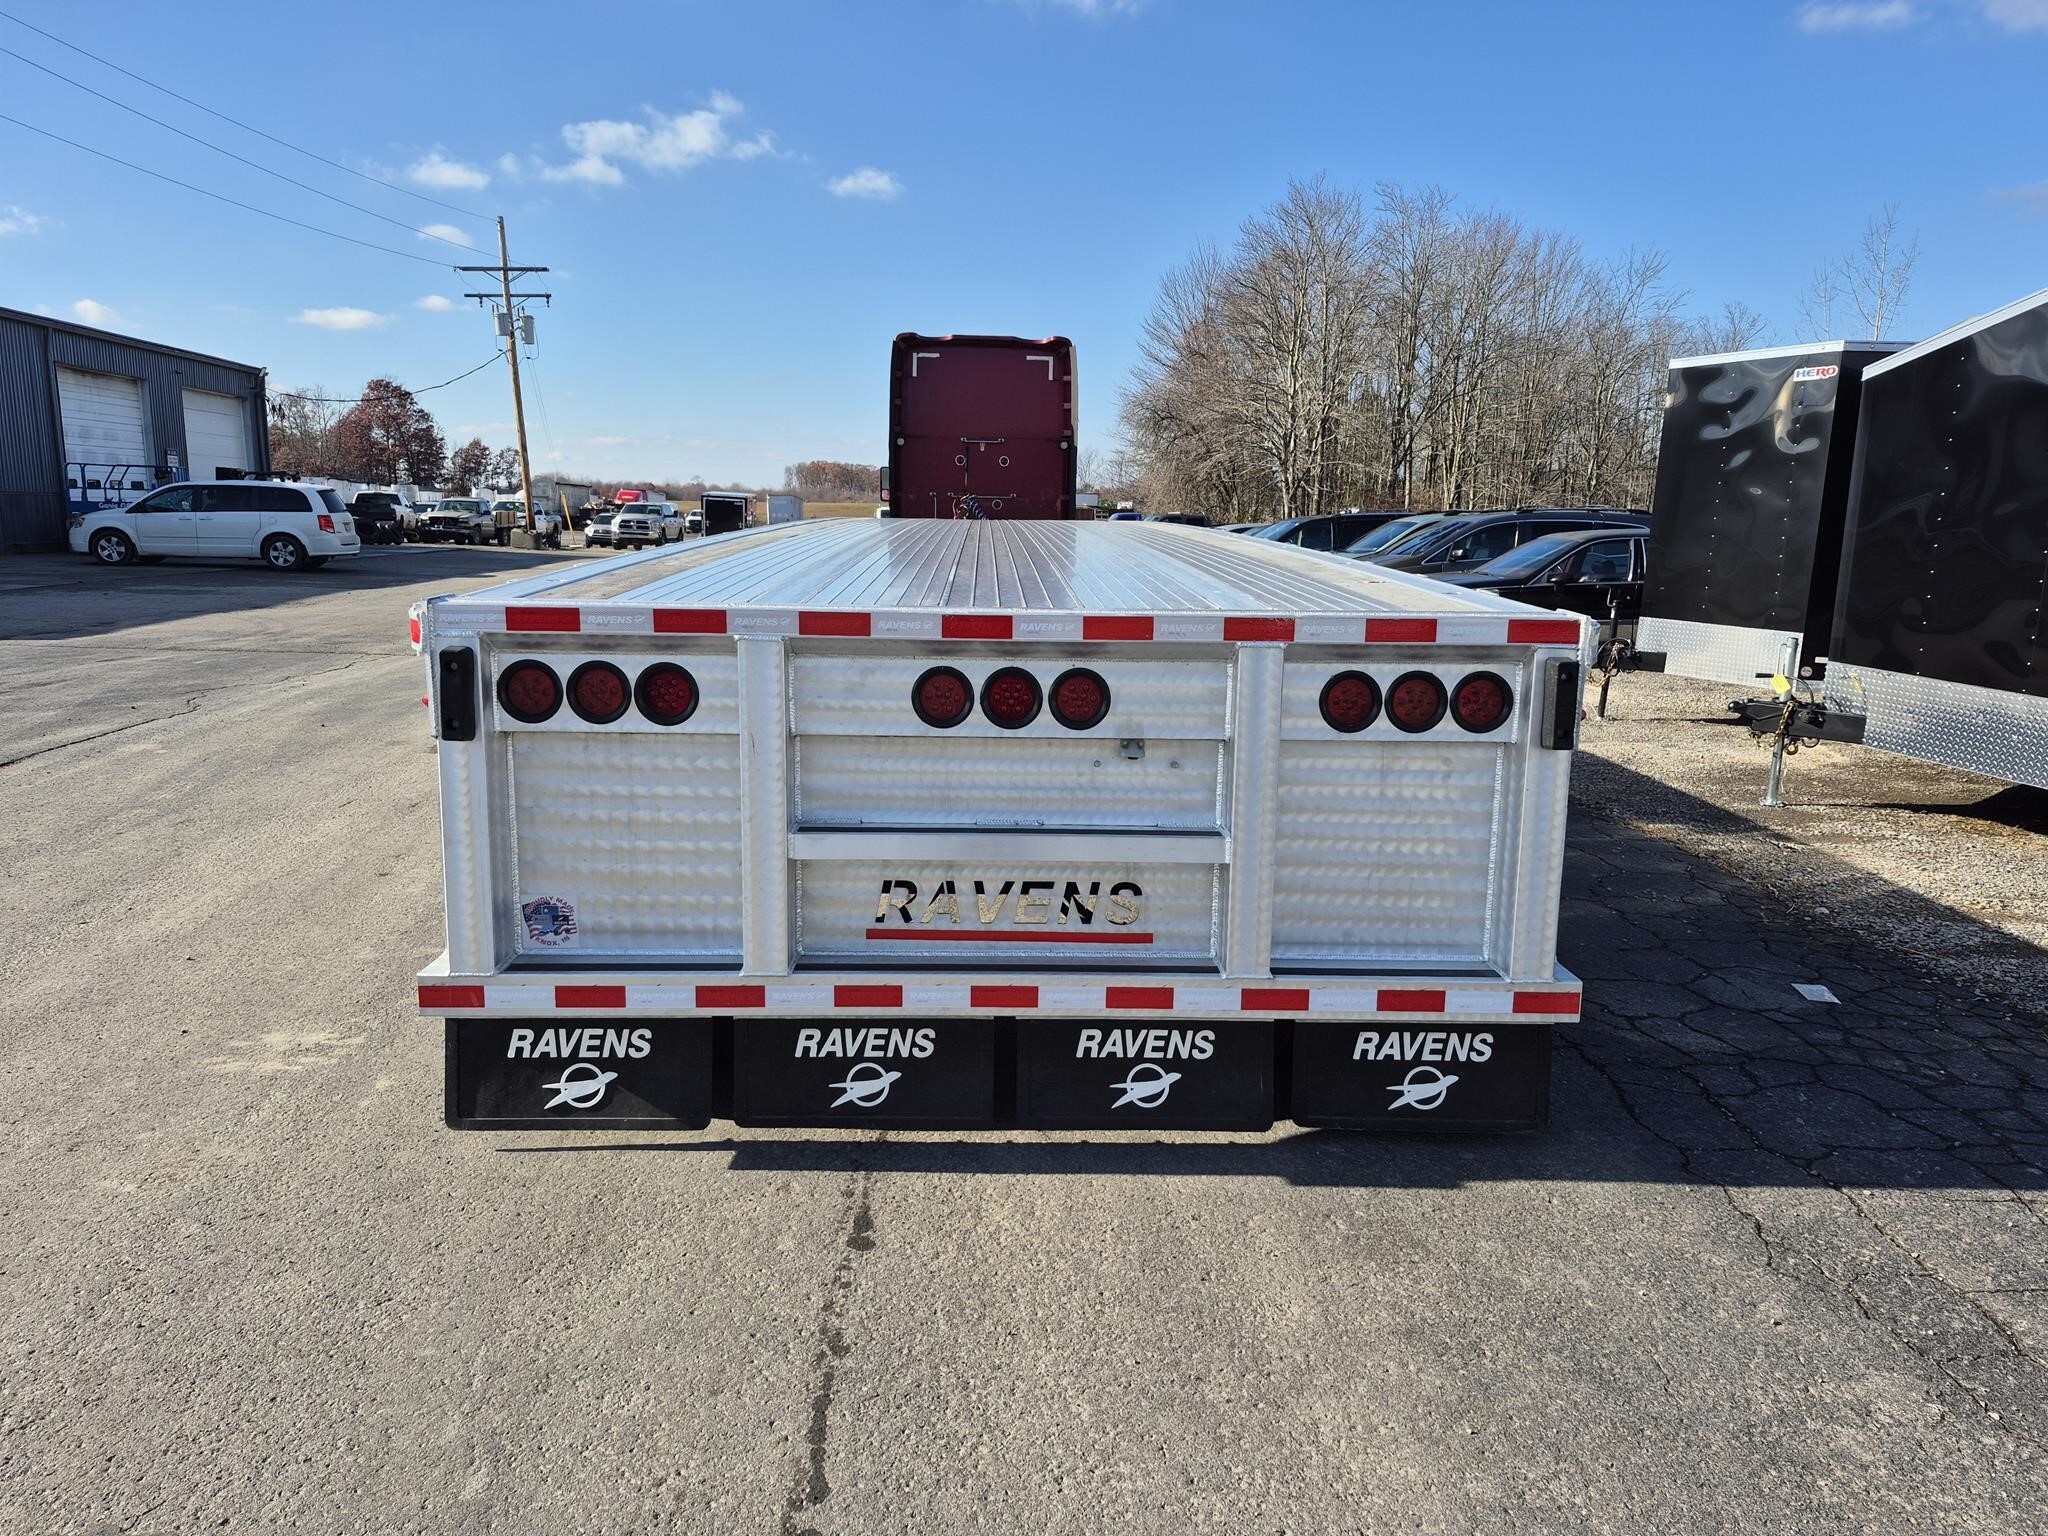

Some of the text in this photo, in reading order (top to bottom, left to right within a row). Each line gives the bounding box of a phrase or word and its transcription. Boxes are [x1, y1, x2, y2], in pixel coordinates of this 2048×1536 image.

[1796, 367, 1837, 378] HERO
[439, 613, 485, 623] RAVENS
[587, 616, 633, 625] RAVENS
[734, 617, 779, 626] RAVENS
[878, 620, 922, 630] RAVENS
[1020, 622, 1065, 632] RAVENS
[1161, 624, 1205, 633] RAVENS
[1302, 625, 1345, 634] RAVENS
[875, 880, 1143, 925] RAVENS
[507, 1028, 652, 1058] RAVENS
[795, 1028, 936, 1058] RAVENS
[1076, 1028, 1216, 1059] RAVENS
[1353, 1031, 1494, 1063] RAVENS
